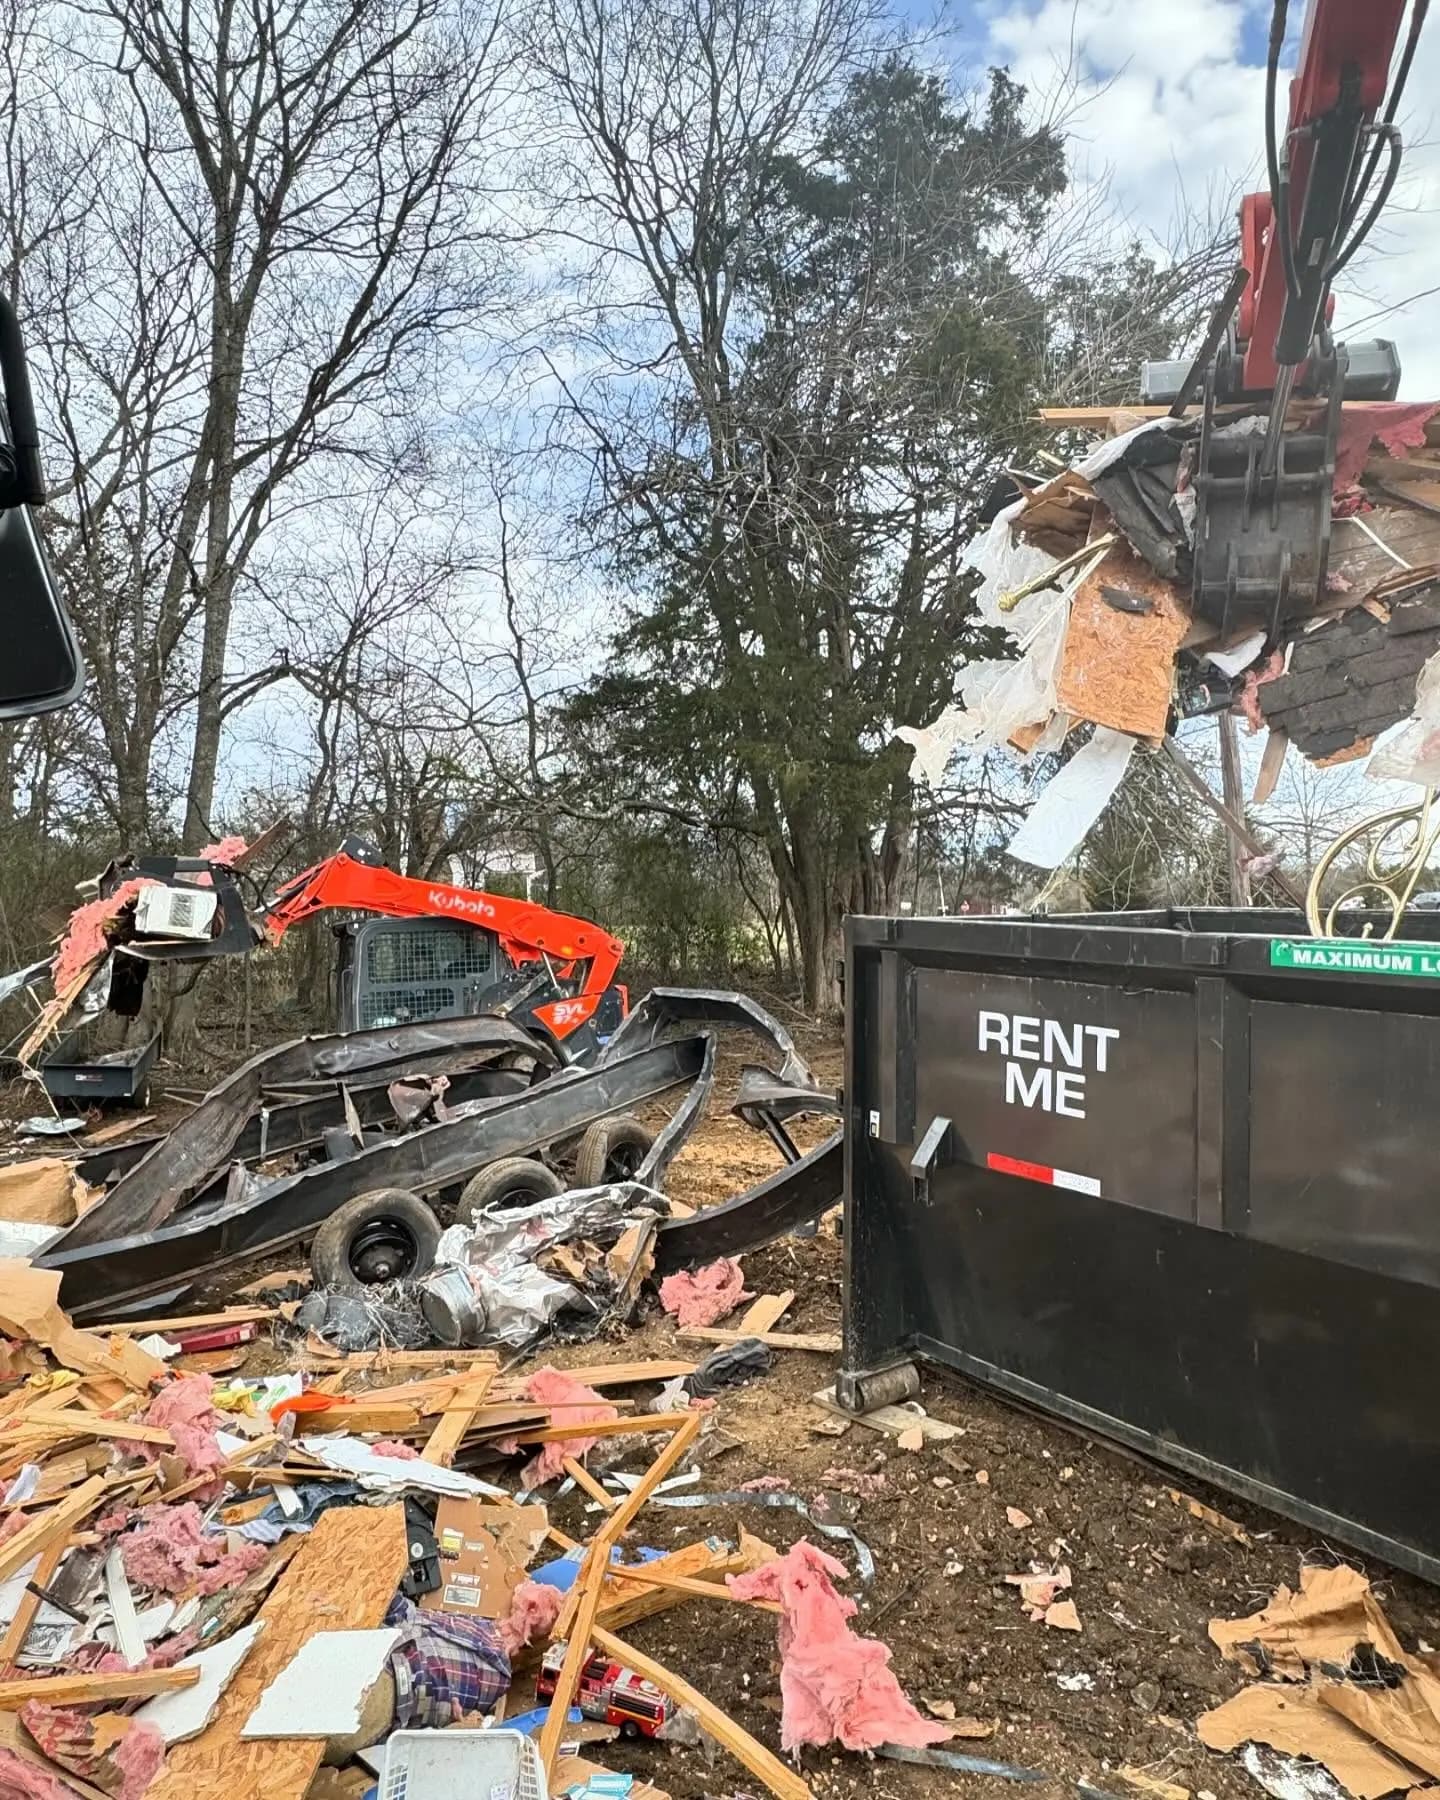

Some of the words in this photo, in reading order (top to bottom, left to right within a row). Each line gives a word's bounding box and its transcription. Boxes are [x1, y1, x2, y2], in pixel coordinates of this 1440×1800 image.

[428, 890, 495, 917] Kubota
[1293, 949, 1412, 970] MAXIMUM
[978, 1010, 1119, 1073] RENT
[1006, 1061, 1085, 1119] ME
